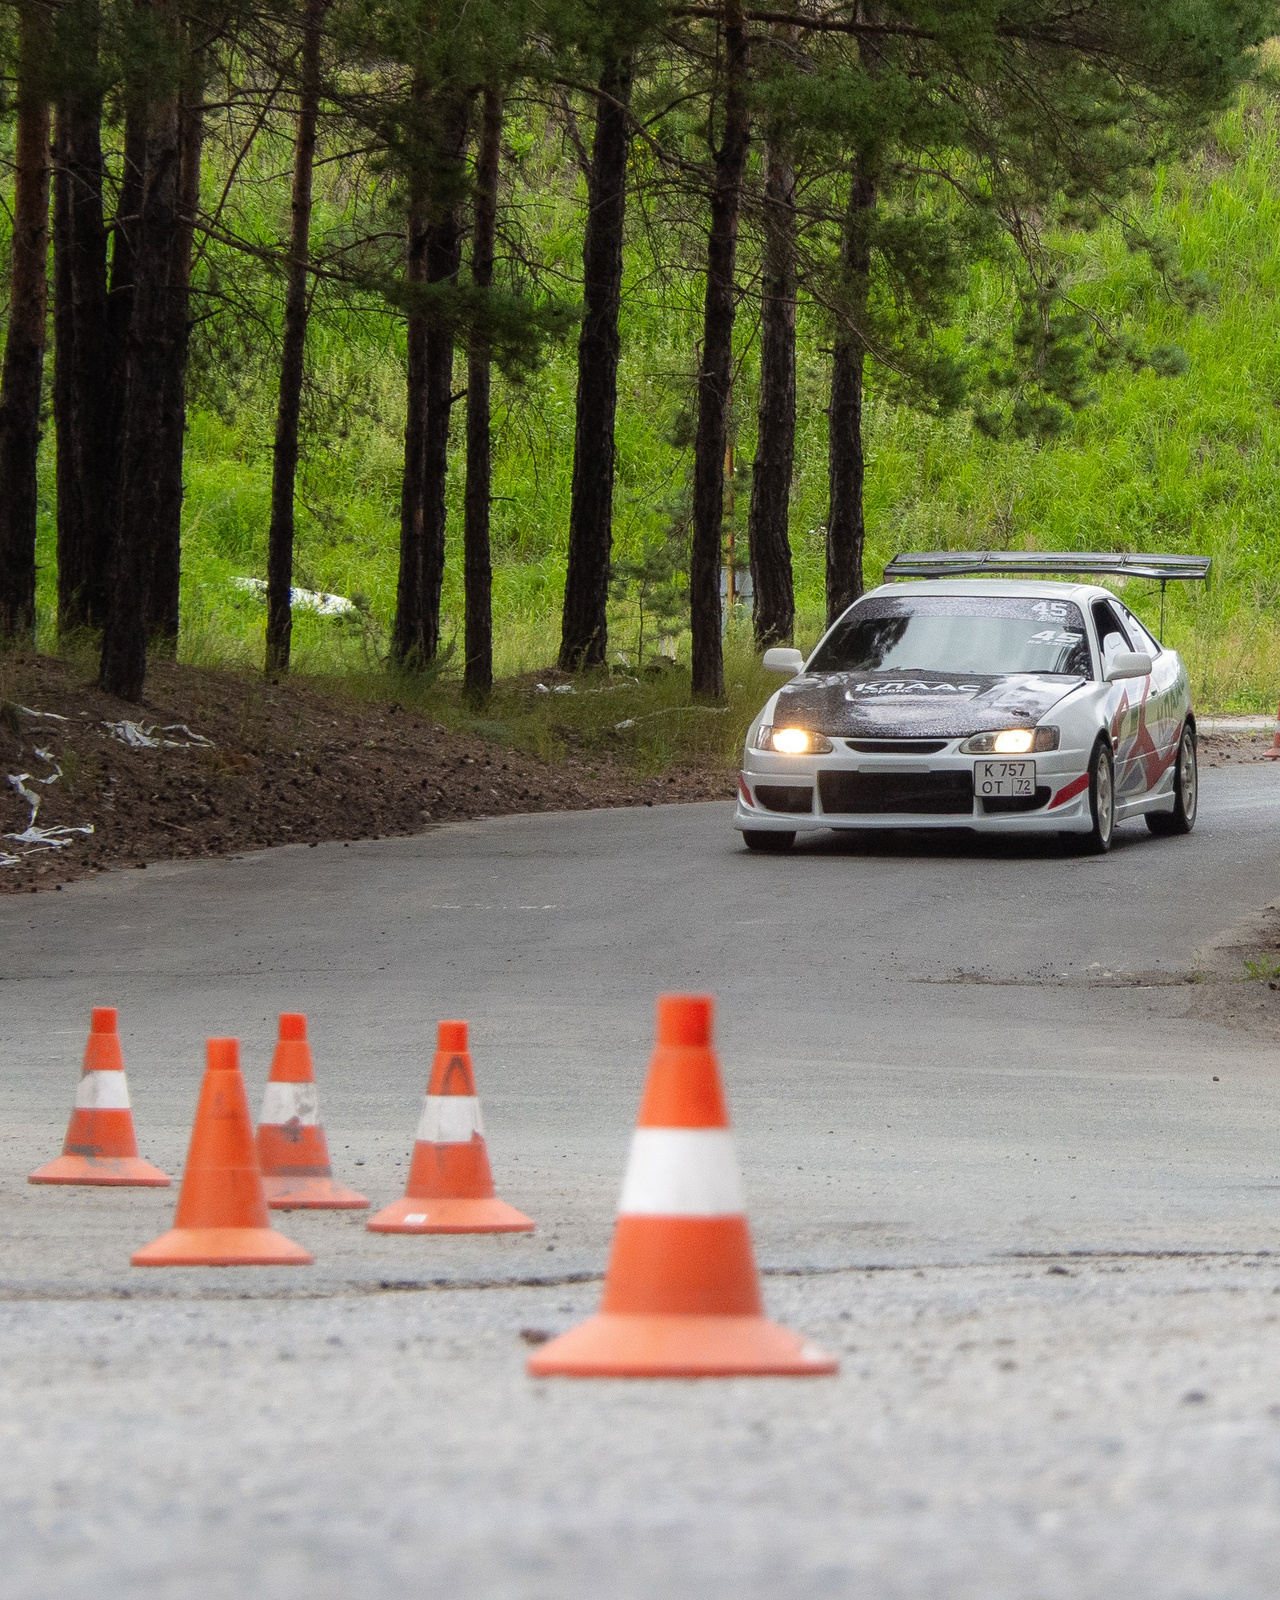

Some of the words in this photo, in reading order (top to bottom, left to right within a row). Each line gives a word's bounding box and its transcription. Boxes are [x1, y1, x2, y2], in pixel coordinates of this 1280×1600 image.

[1031, 602, 1068, 617] 45
[1031, 630, 1083, 643] 45
[1000, 764, 1025, 776] 757
[982, 781, 1003, 794] ОТ
[1017, 780, 1030, 790] 72
